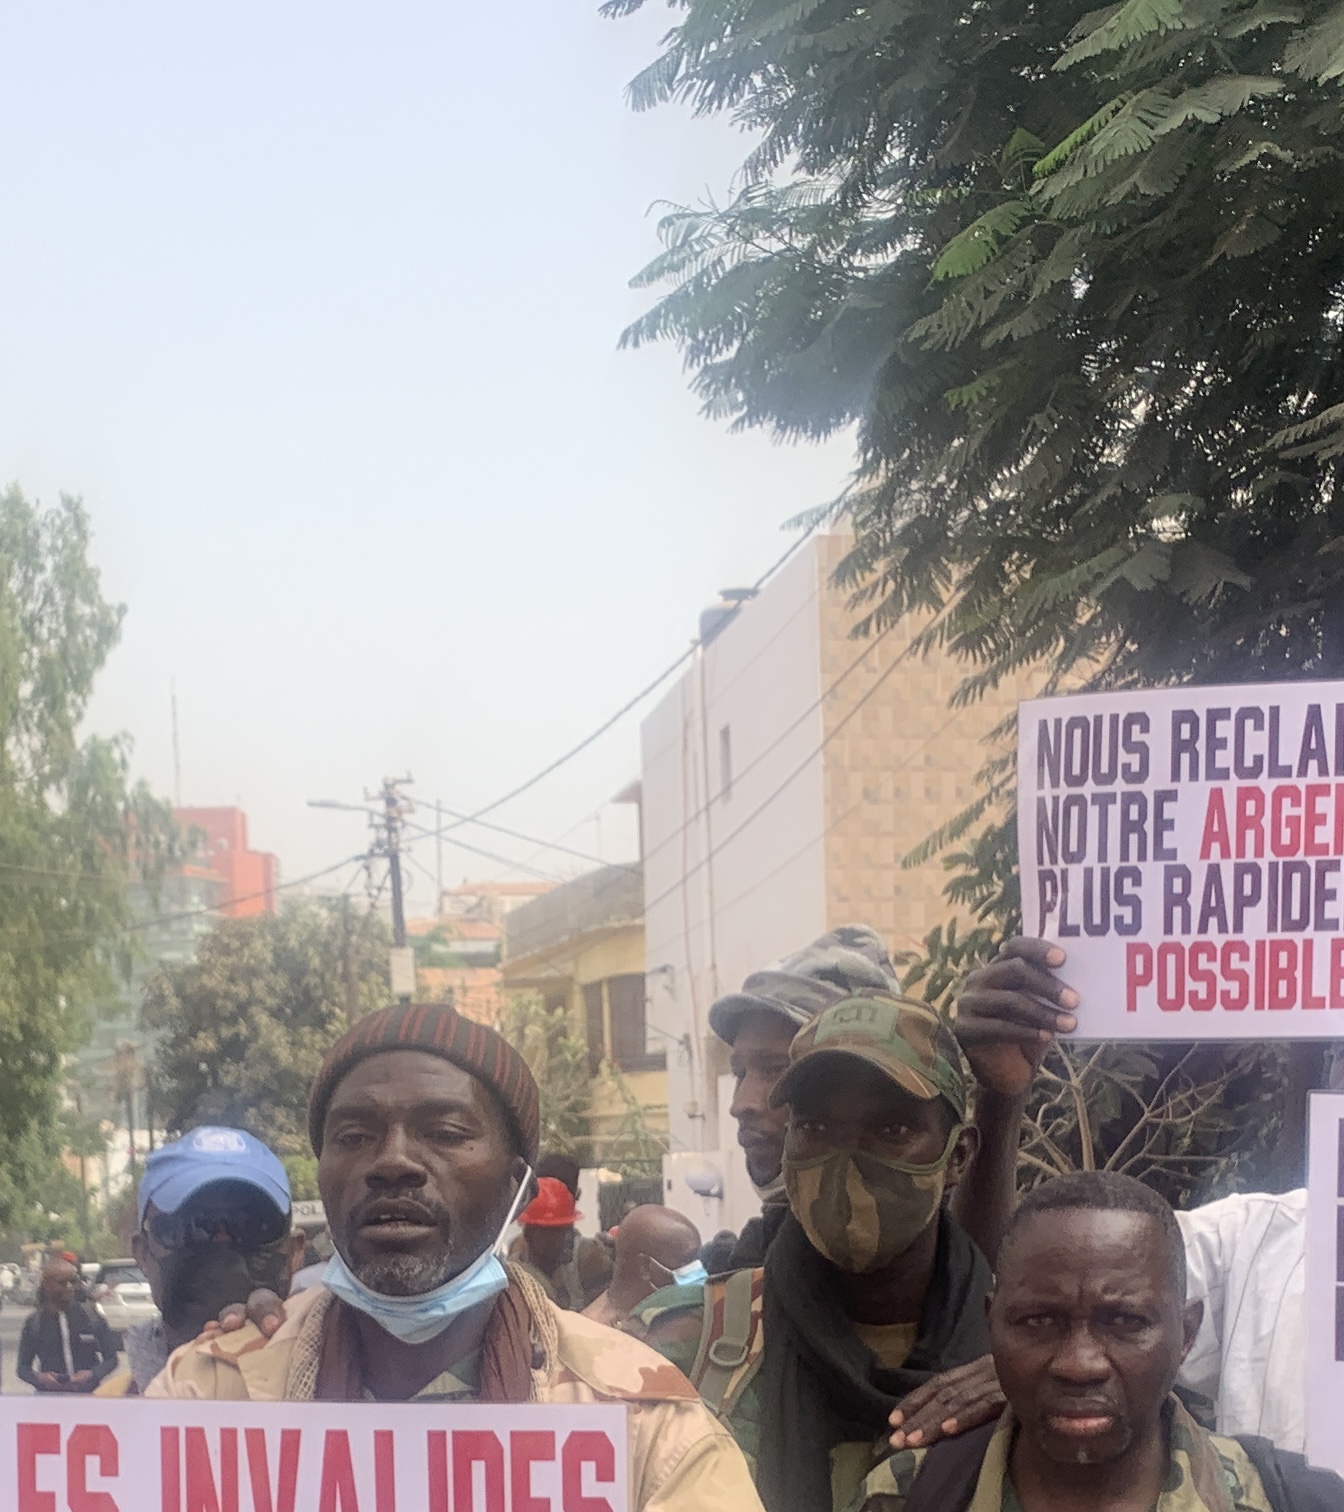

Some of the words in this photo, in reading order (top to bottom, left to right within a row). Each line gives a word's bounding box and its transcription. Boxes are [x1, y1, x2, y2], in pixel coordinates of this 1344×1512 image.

[1036, 711, 1150, 790] NOUS
[1036, 789, 1178, 866] NOTRE
[1038, 866, 1143, 938] PLUS
